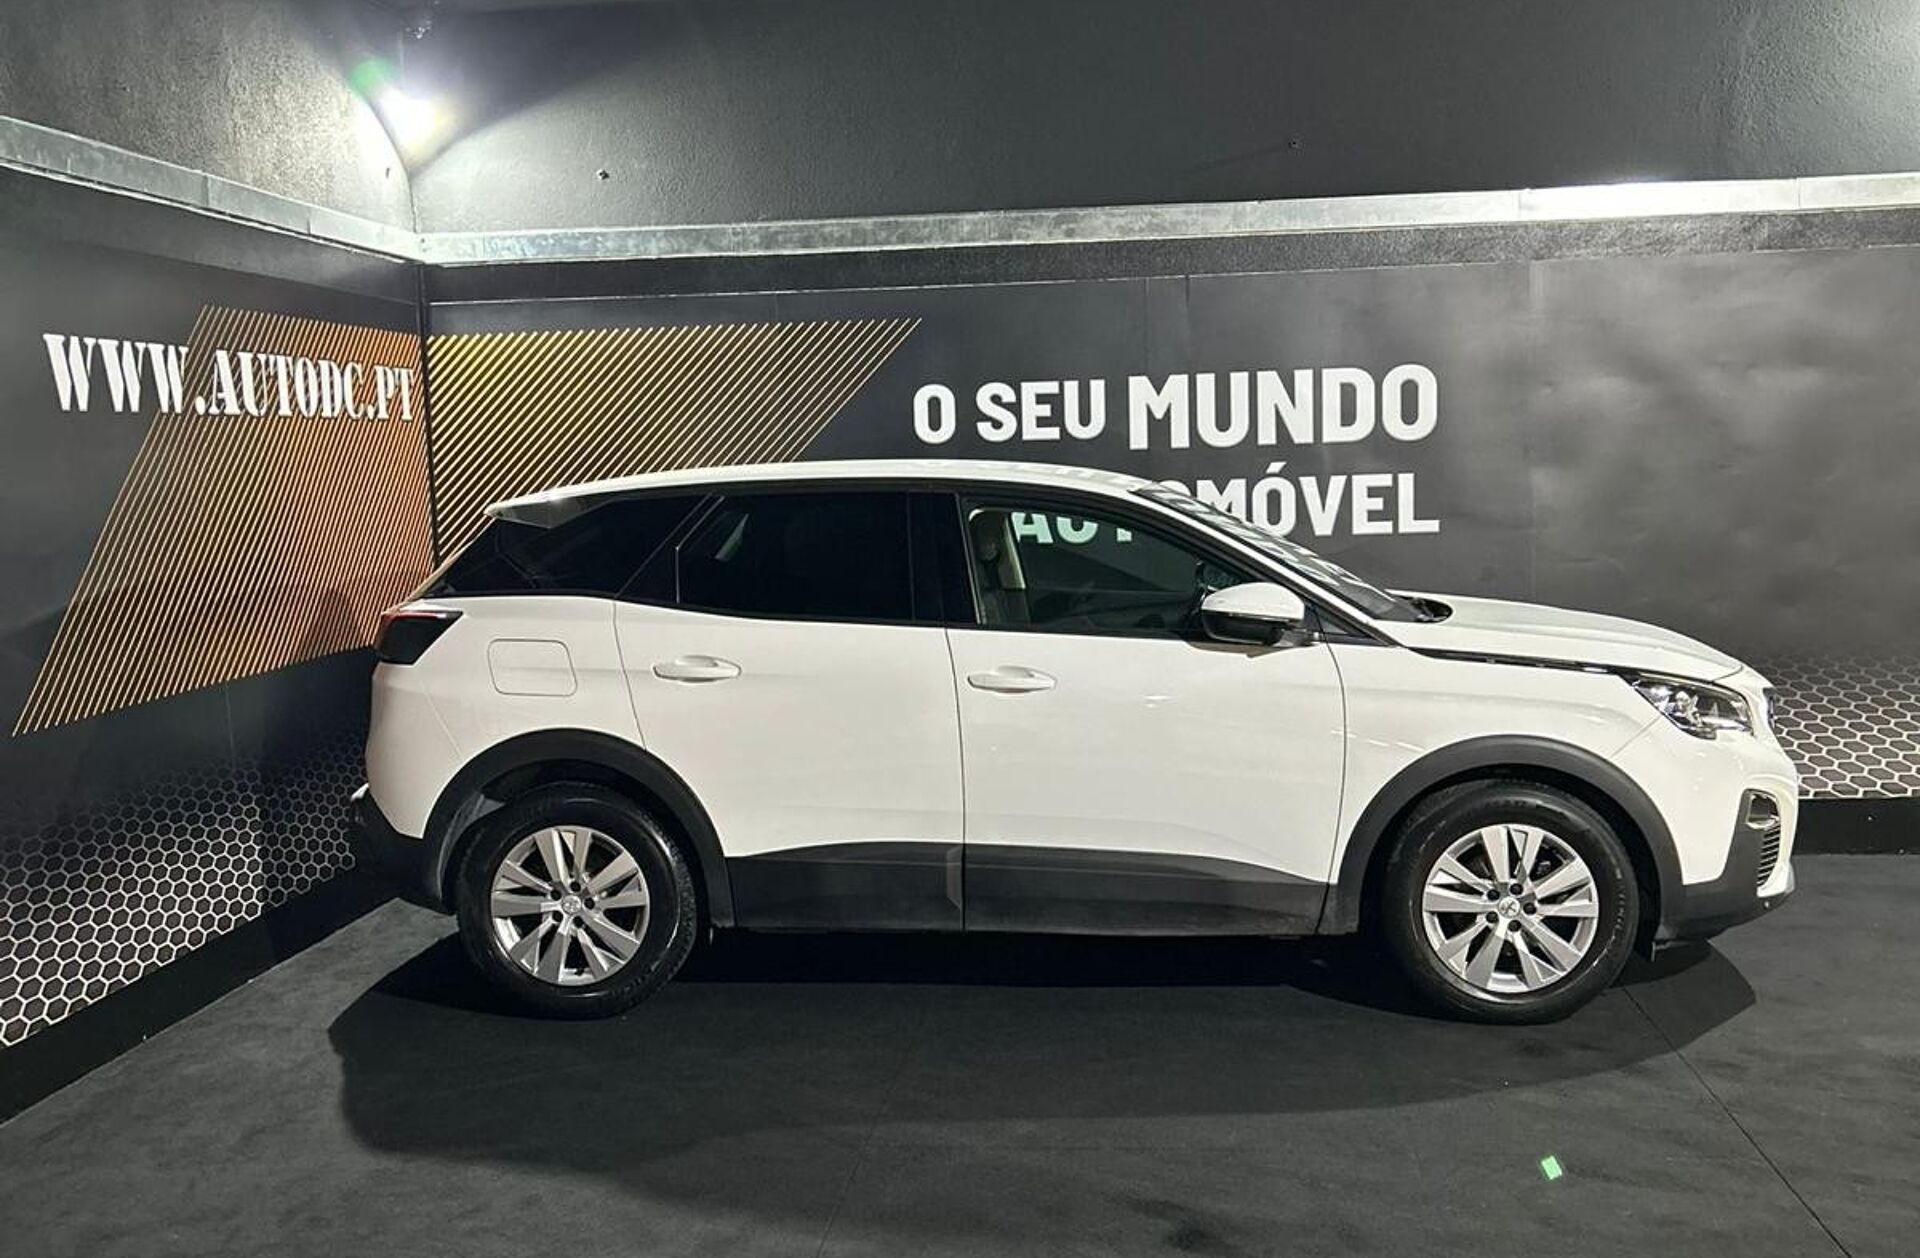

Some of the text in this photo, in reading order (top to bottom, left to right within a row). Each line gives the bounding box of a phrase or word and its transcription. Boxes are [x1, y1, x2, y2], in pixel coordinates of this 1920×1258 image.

[42, 333, 415, 422] WWW.AUTODC.PT
[913, 364, 1438, 450] O SEU MUNDO
[1011, 462, 1440, 544] AMÓVEL
